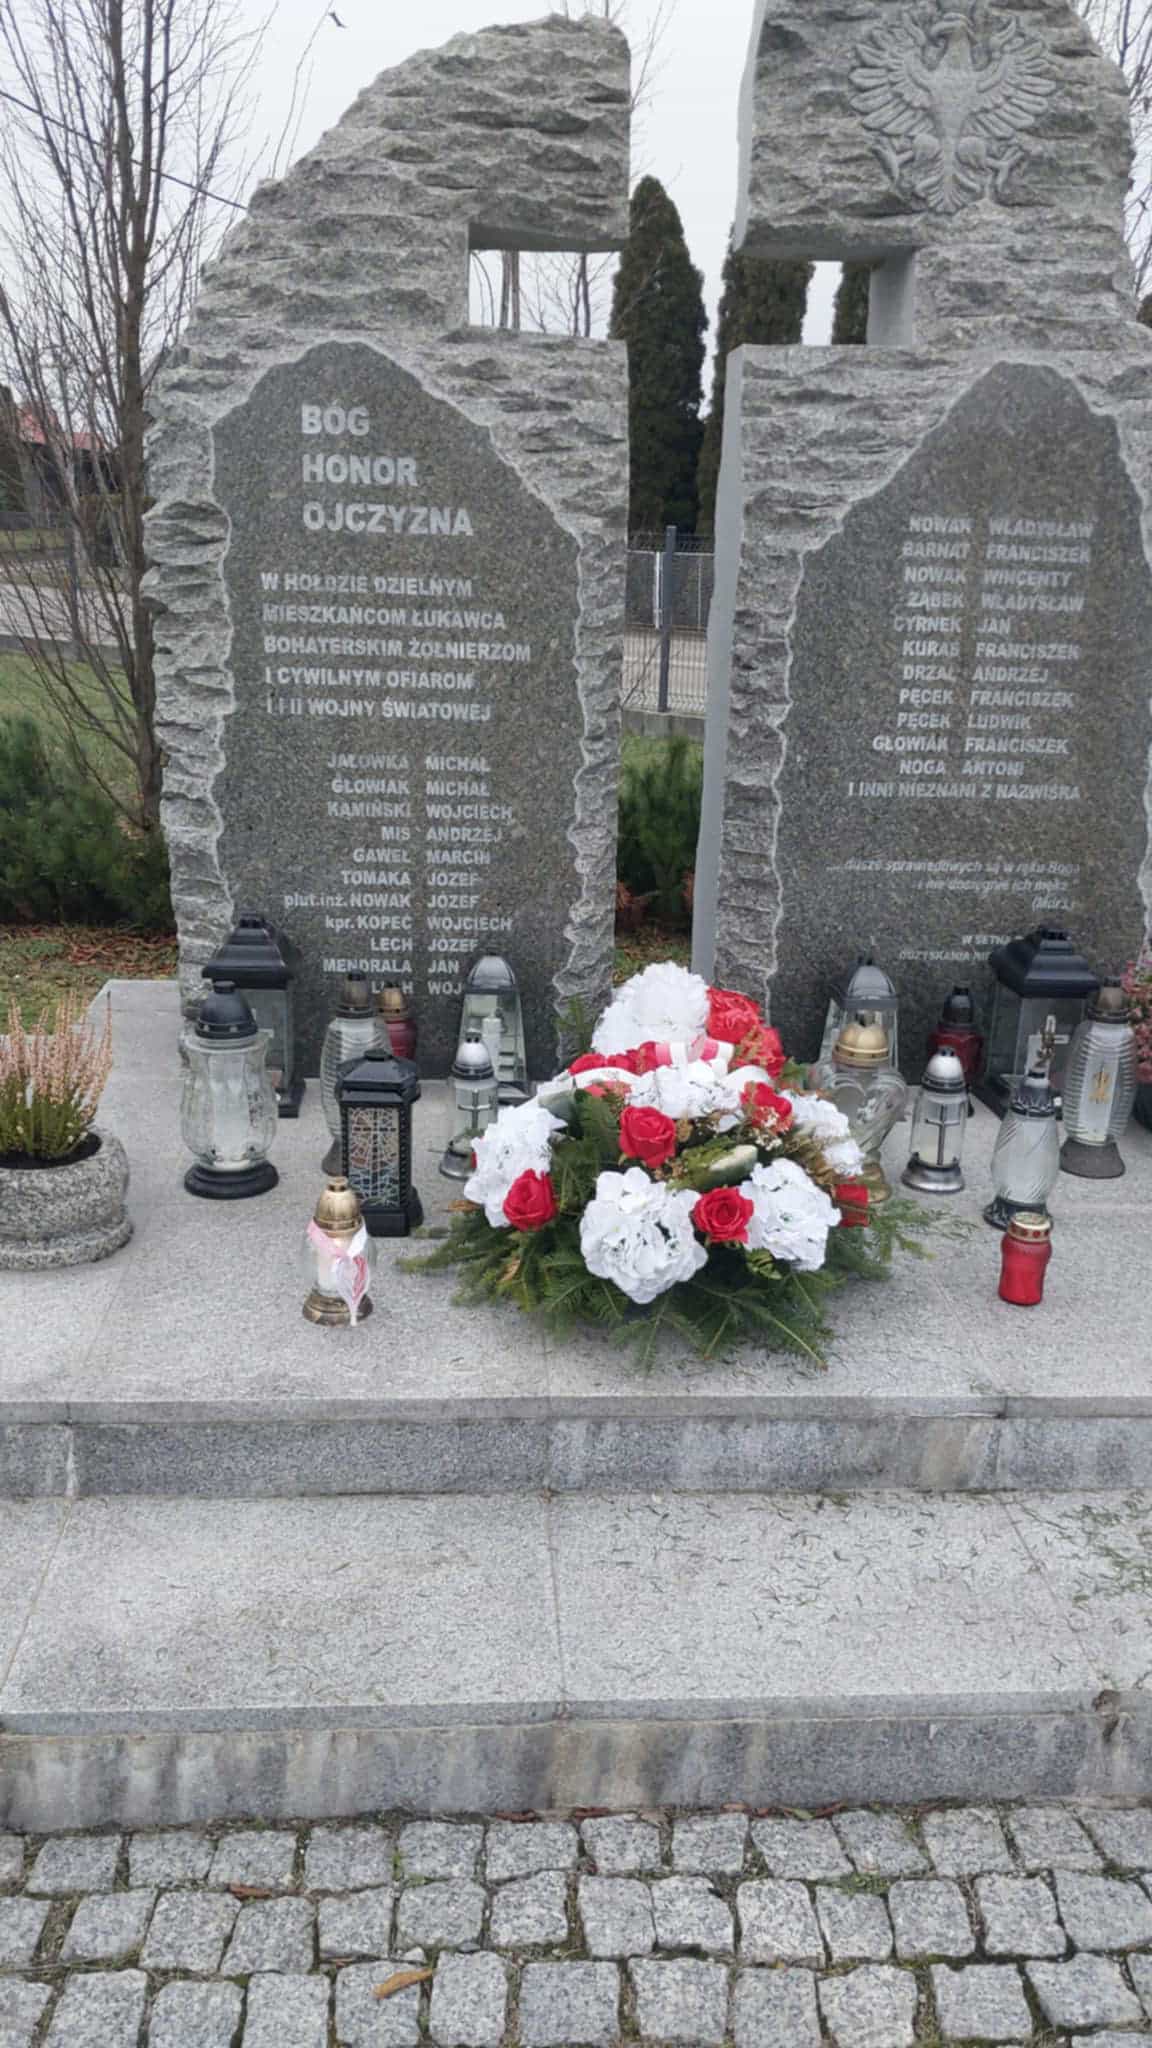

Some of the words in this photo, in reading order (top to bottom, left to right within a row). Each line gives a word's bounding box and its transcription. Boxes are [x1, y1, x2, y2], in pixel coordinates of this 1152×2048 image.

[301, 401, 370, 436] BÓG
[302, 453, 418, 487] HONOR
[303, 501, 474, 536] OJCZYZNA
[909, 517, 973, 534] NOWAK
[902, 542, 971, 560] BARNAT
[986, 544, 1091, 564] FRANCISZEK
[261, 572, 279, 591] W
[285, 574, 368, 593] HOŁDZIE
[374, 576, 472, 597] DZIELNYM
[905, 566, 967, 584] NOWAK
[984, 569, 1072, 587] WINCENTY
[412, 607, 506, 629] ŁUKAWCA
[893, 616, 962, 633] CYRNEK
[977, 617, 1011, 634] JAN
[264, 636, 402, 656] BOHATERSKIM
[408, 637, 530, 661] ŻOŁNIERZOM
[975, 642, 1081, 661] FRANCISZEK
[265, 667, 272, 685] I
[277, 667, 381, 687] CYWILNYM
[386, 670, 474, 690] OFIAROM
[972, 665, 1049, 684] ANDRZEJ
[290, 699, 302, 714] II
[308, 698, 375, 717] WOJNY
[382, 696, 491, 721] ŚWIATOWEJ
[970, 690, 1074, 709] FRANCISZEK
[967, 713, 1032, 730] LUDWIK
[964, 736, 1070, 754] FRANCISZEK
[900, 759, 946, 775] NOGA
[961, 760, 1025, 777] ANTONI
[426, 780, 490, 797] MICHAŁ
[858, 782, 896, 797] INNI
[898, 782, 976, 799] NIEZNANI
[982, 784, 992, 799] Z
[426, 803, 513, 820] WOJCIECH
[426, 826, 502, 843] ANDRZEJ
[426, 850, 491, 866] MARCIN
[340, 870, 411, 886] TOMAKA
[350, 893, 411, 908] NOWAK
[427, 916, 513, 932] WOJCIECH
[322, 958, 413, 974] MENDRALA
[427, 958, 460, 974] JAN
